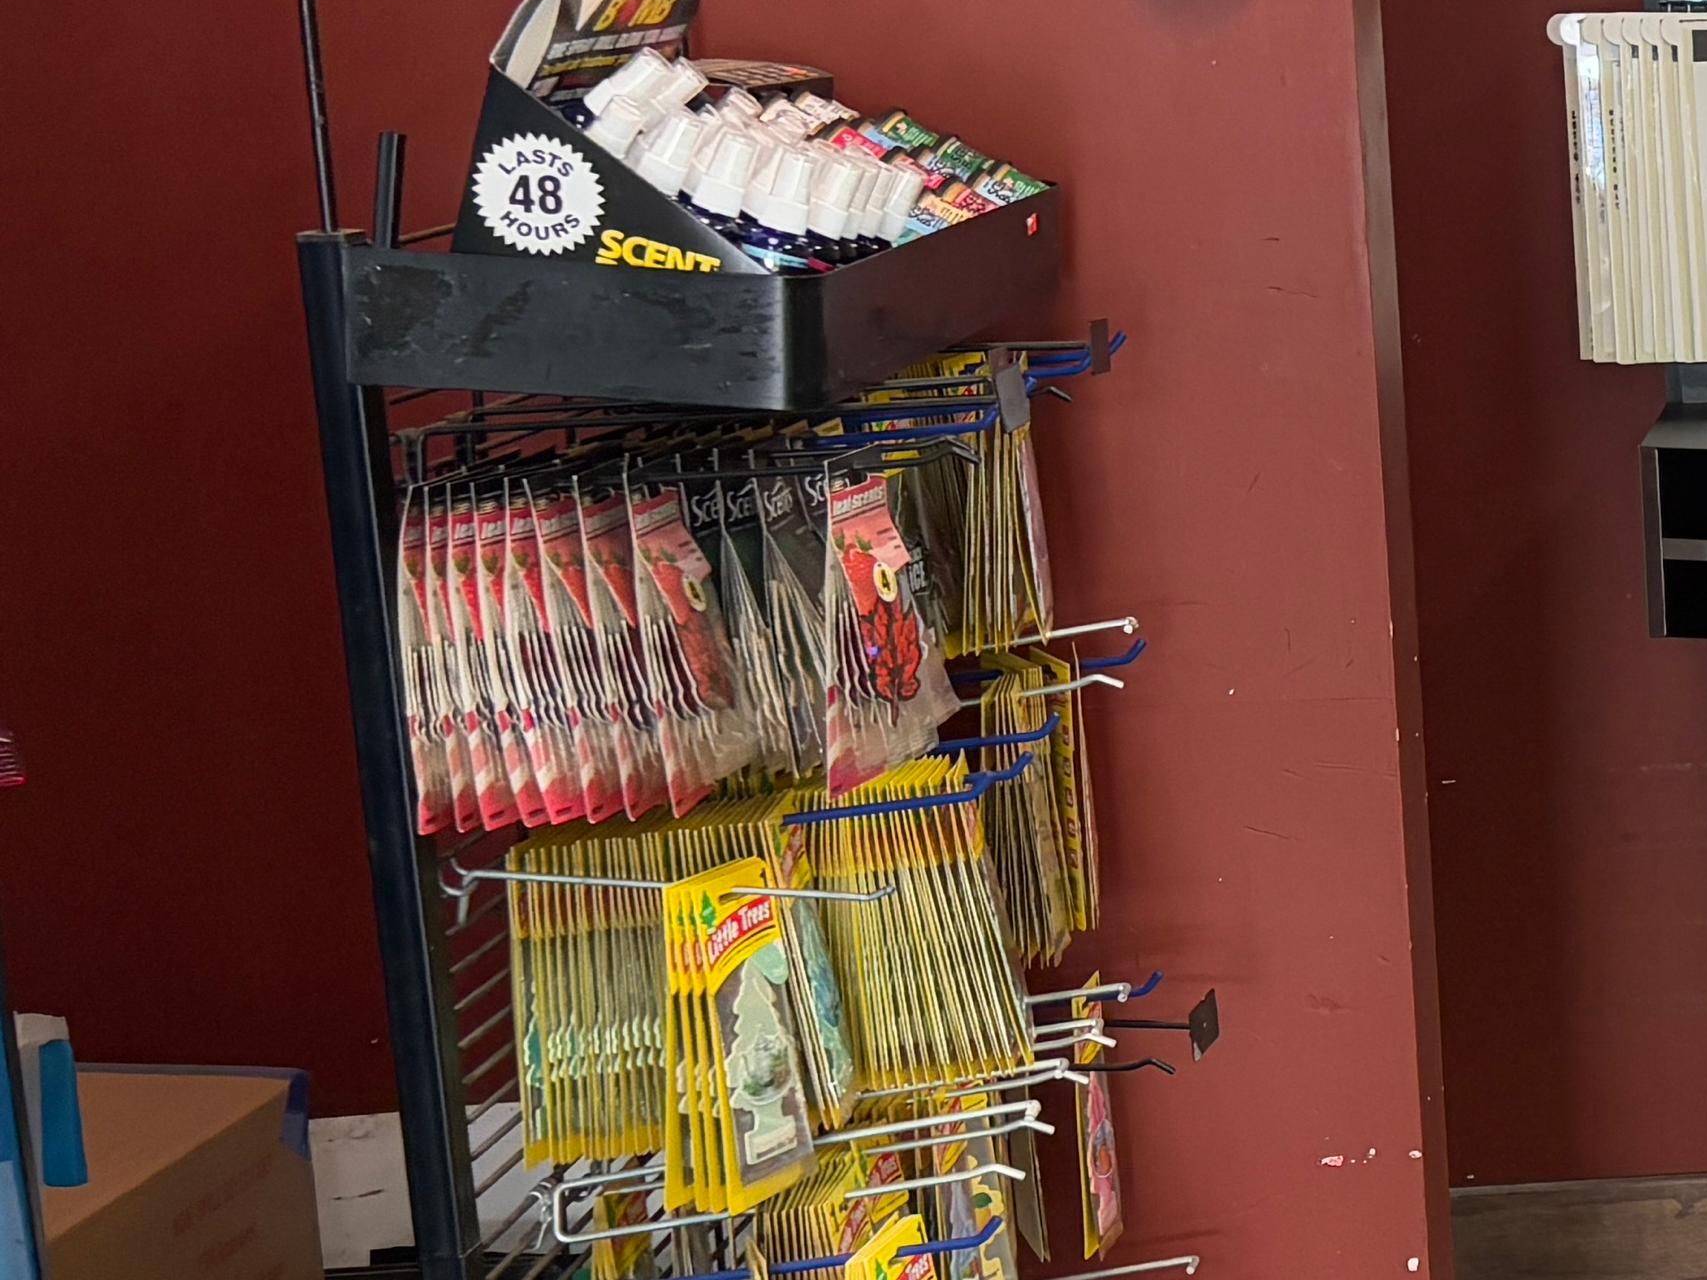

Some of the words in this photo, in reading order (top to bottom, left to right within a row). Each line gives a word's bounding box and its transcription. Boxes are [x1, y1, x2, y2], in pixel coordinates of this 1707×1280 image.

[498, 150, 574, 177] LASTS
[509, 174, 563, 214] 48
[500, 211, 580, 240] HOURS
[595, 229, 721, 272] SCENT
[708, 918, 740, 965] Little
[738, 901, 770, 931] Trees
